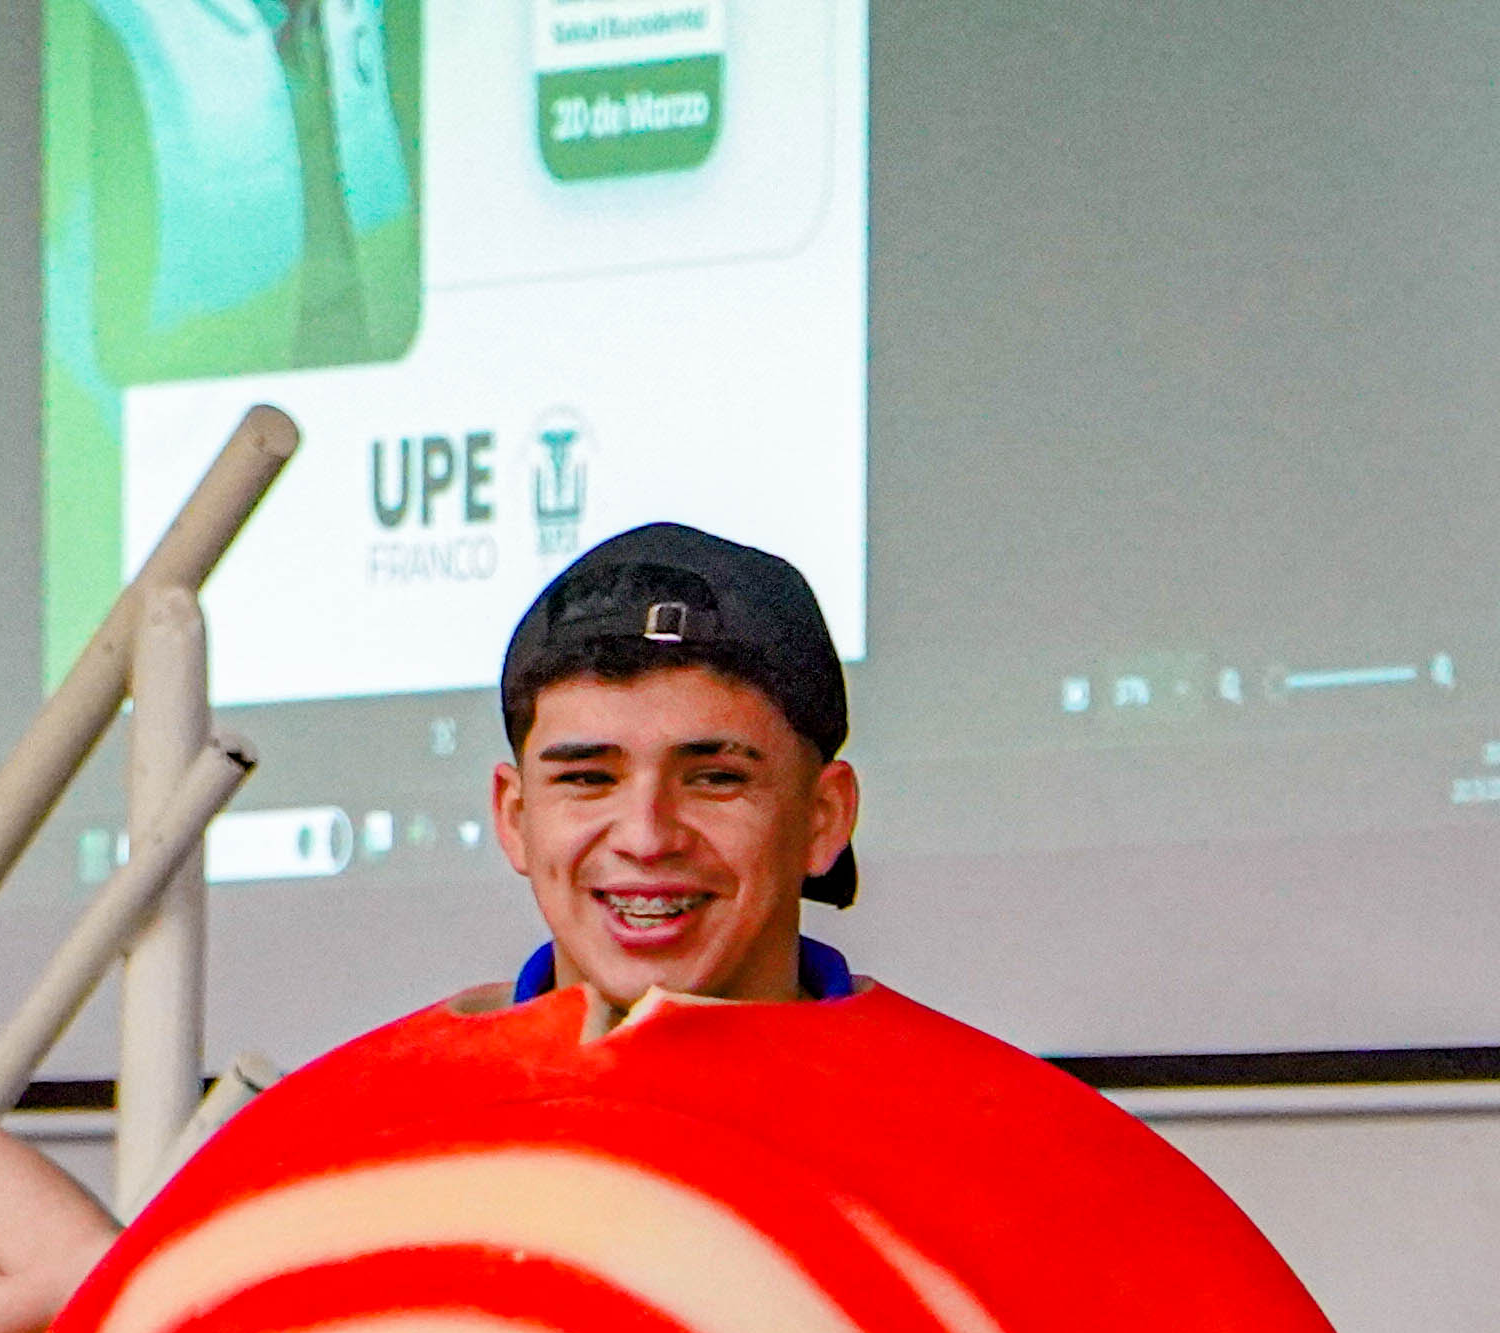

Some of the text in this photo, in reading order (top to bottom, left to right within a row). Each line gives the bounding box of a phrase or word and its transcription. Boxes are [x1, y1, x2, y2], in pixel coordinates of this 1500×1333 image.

[551, 90, 710, 141] 20 de Marzo
[371, 430, 494, 527] UPE
[367, 536, 497, 584] FRANCO
